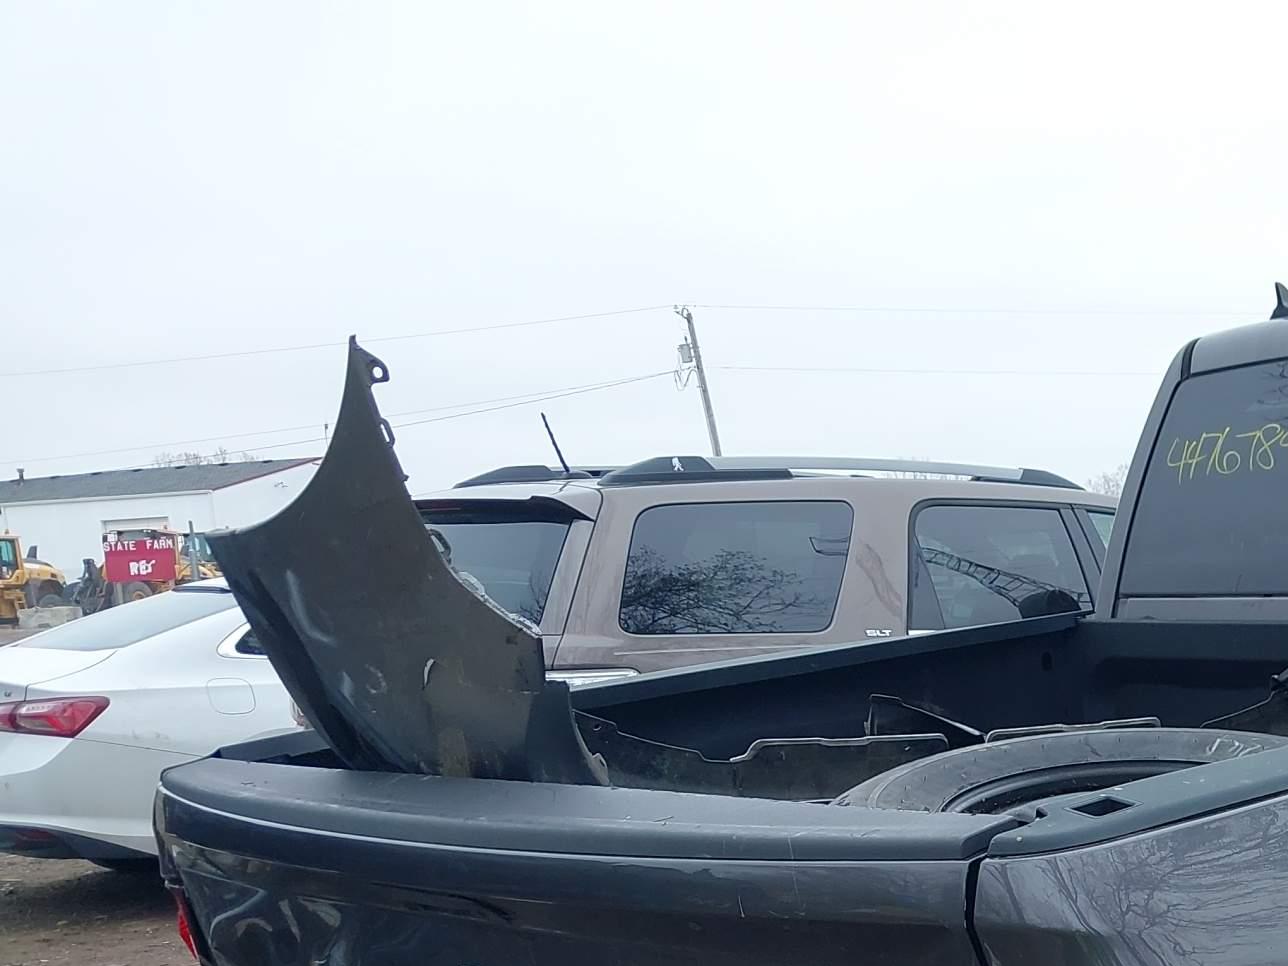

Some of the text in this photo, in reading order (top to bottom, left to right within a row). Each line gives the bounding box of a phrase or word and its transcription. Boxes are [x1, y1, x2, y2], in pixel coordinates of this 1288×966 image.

[103, 539, 174, 551] STATE FARM
[864, 629, 892, 637] SLT
